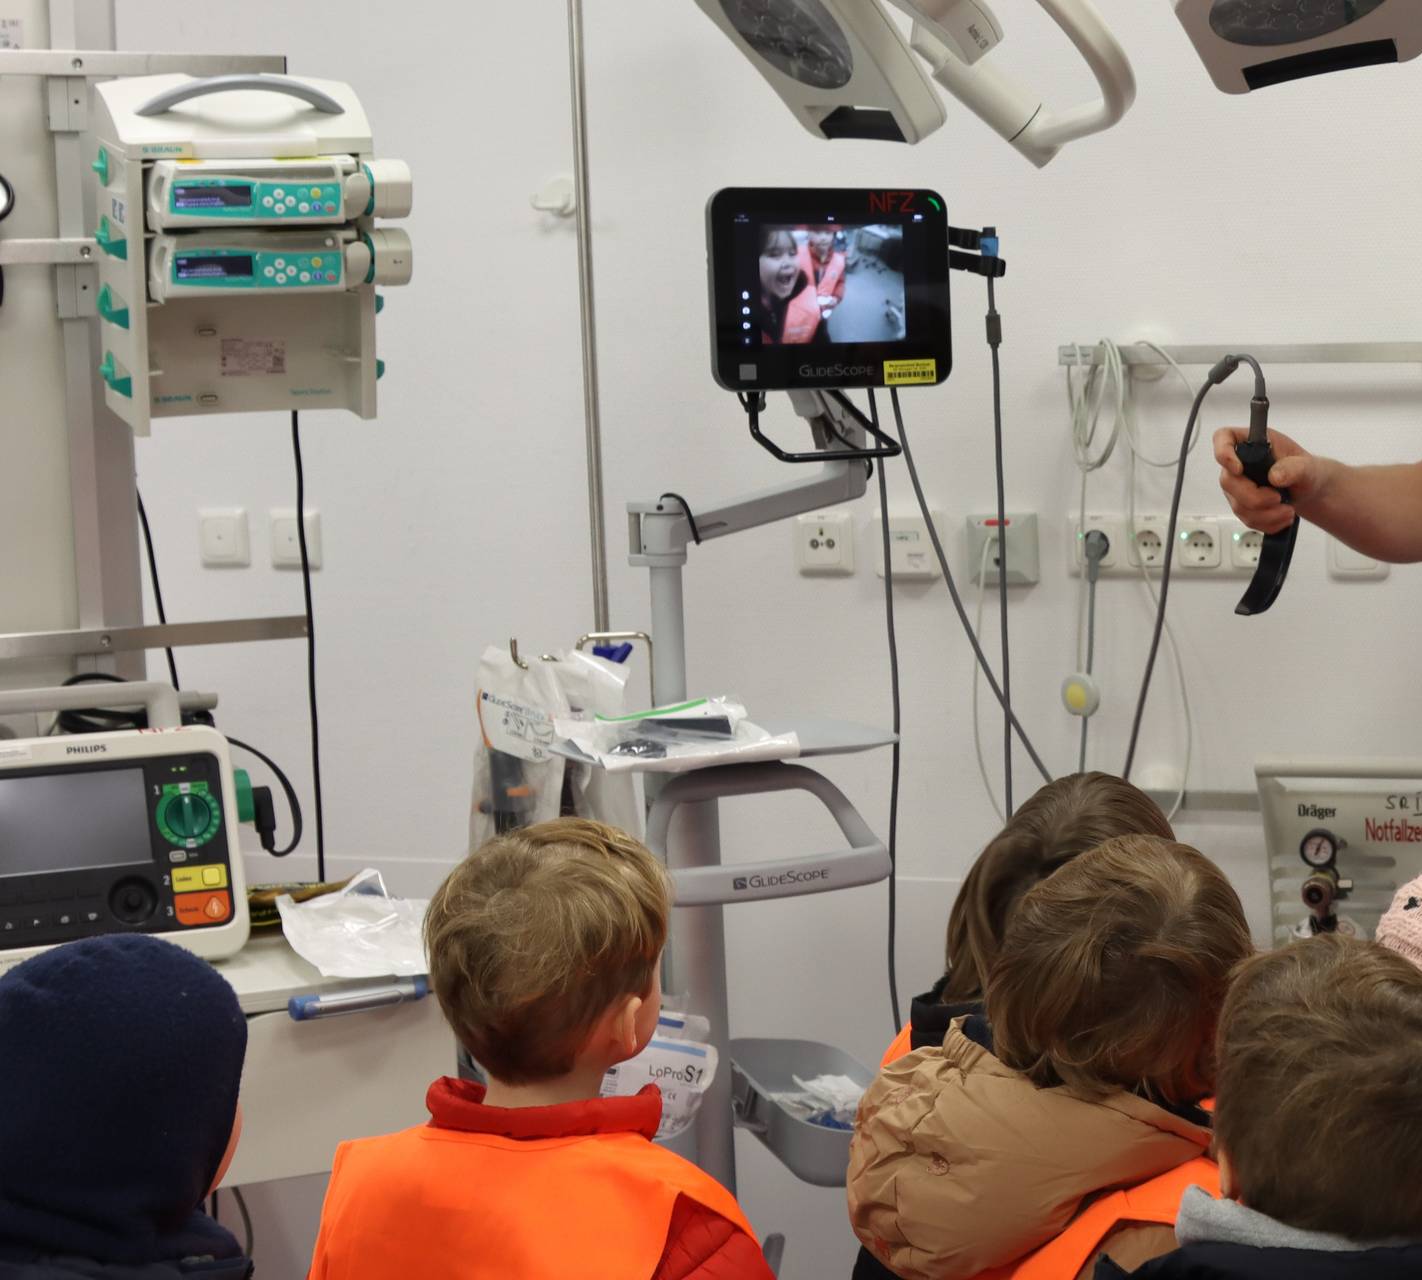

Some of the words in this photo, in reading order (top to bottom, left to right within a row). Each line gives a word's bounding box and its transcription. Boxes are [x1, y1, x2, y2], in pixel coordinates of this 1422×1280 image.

[868, 191, 916, 213] NFZ
[66, 744, 107, 756] PHILIPS
[153, 784, 160, 794] 1
[1298, 803, 1337, 819] Dräger
[163, 875, 170, 885] 2
[166, 906, 174, 916] 3
